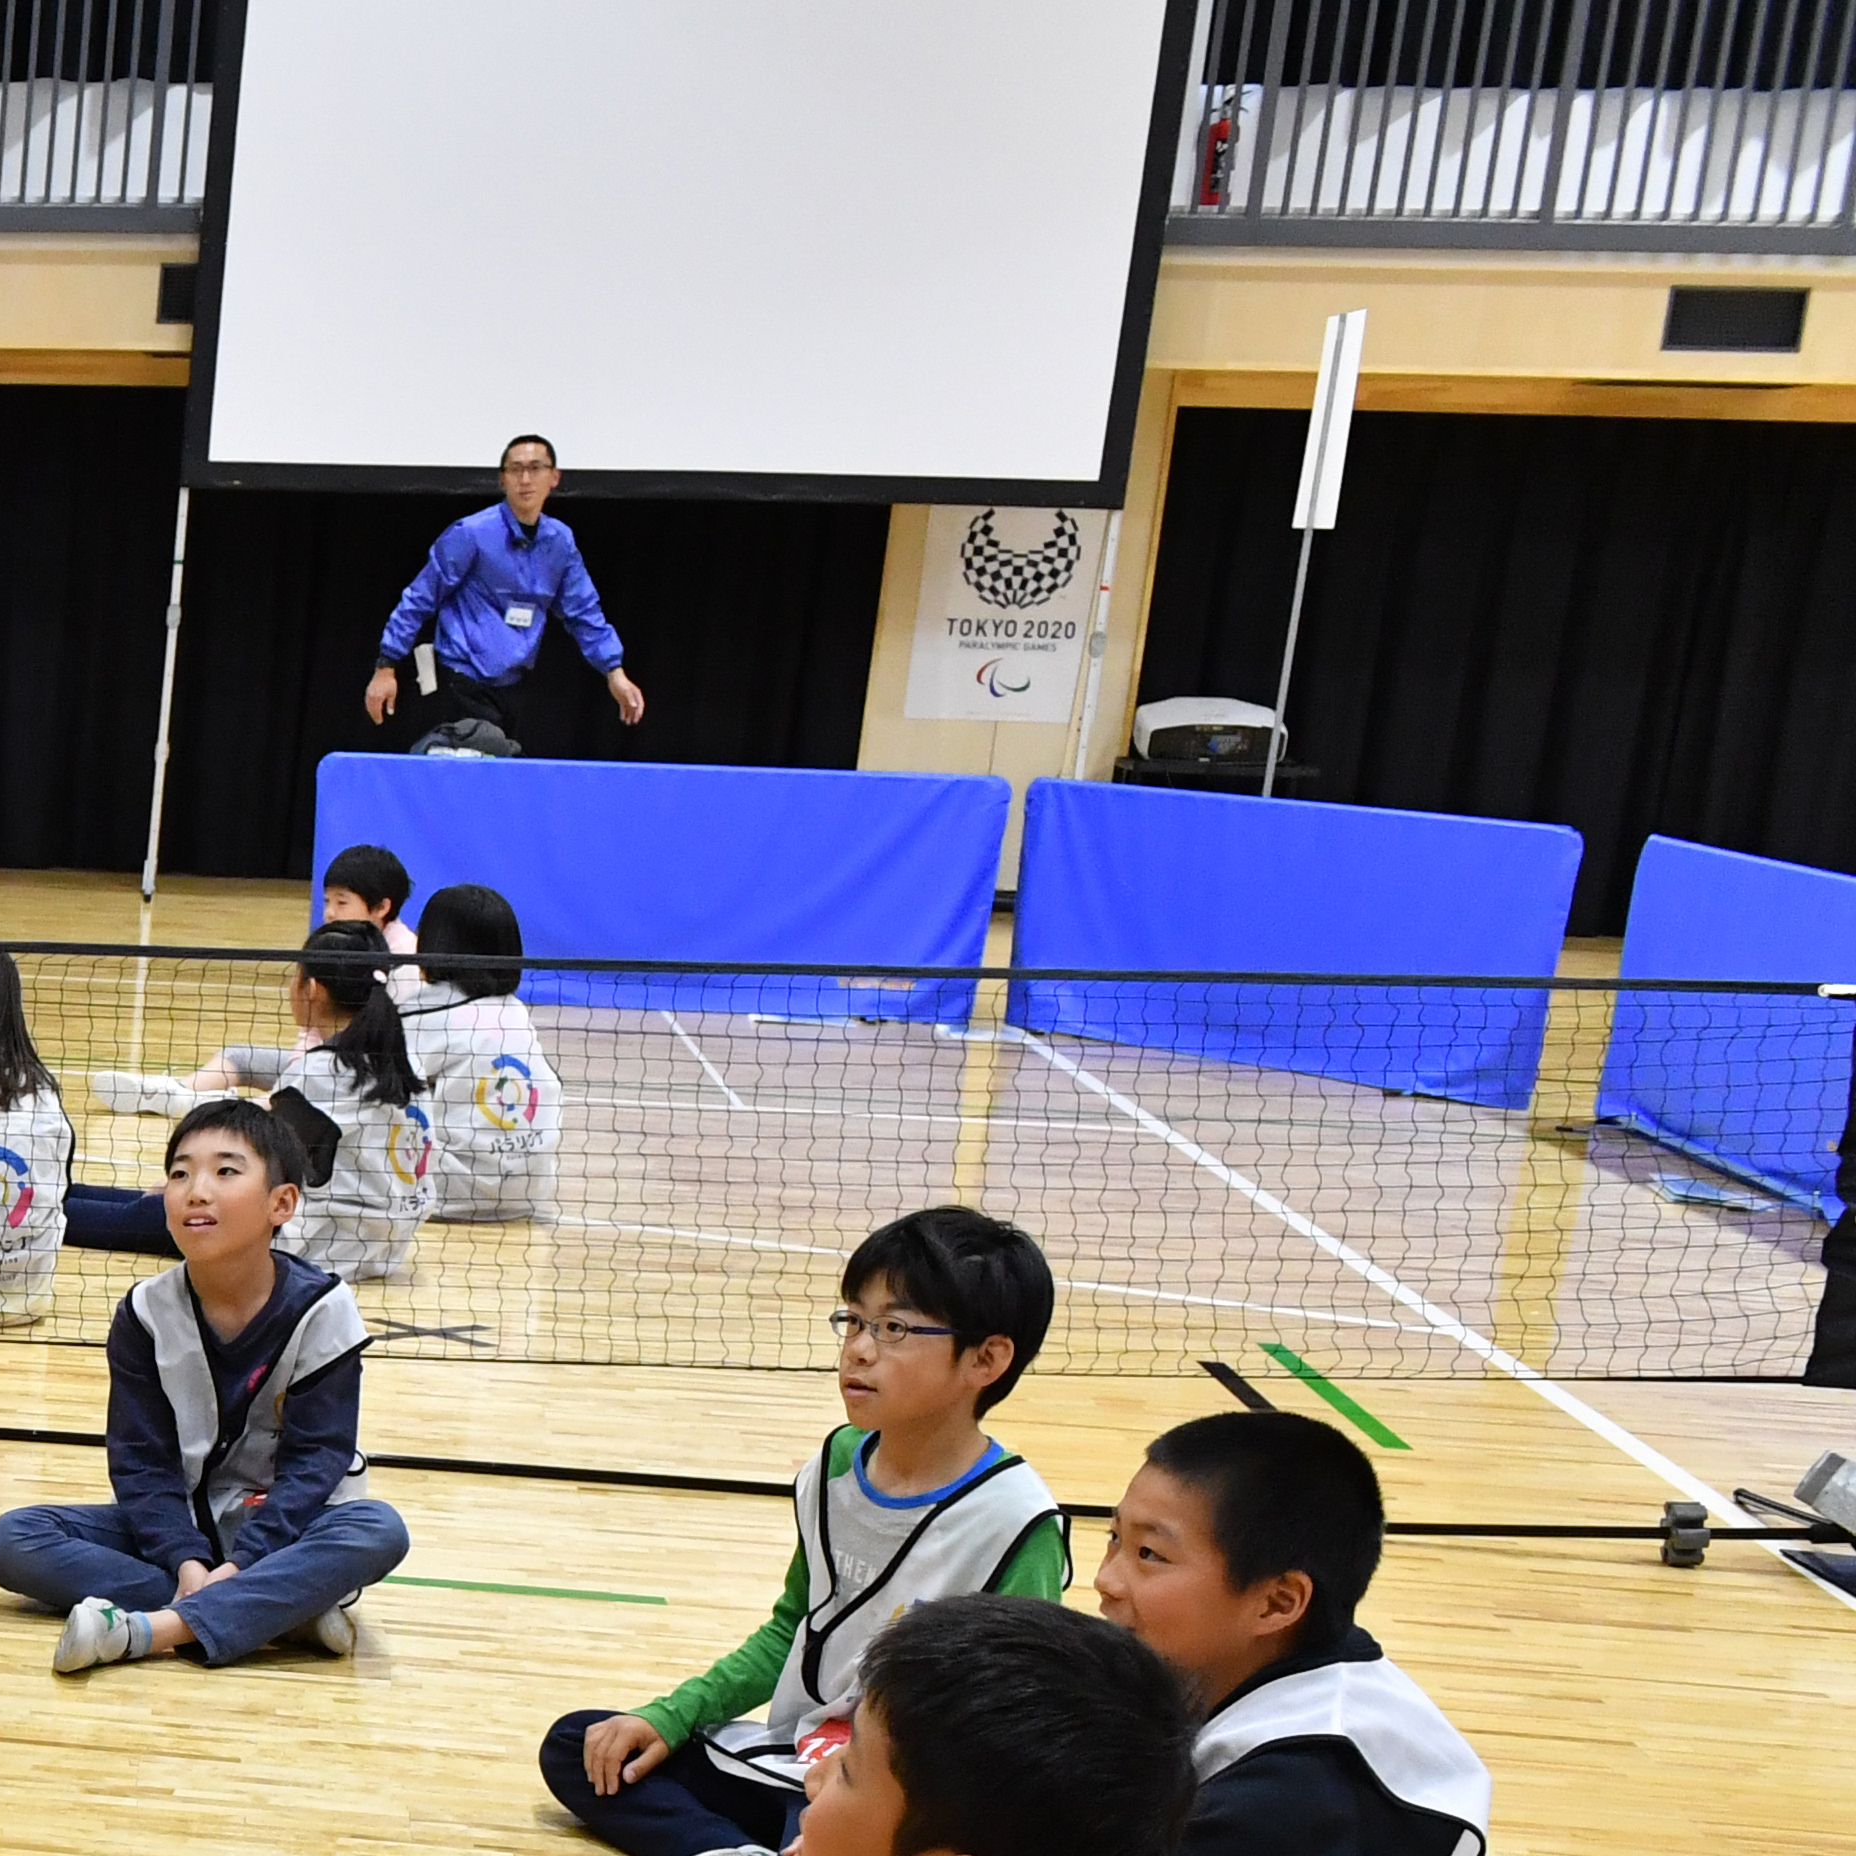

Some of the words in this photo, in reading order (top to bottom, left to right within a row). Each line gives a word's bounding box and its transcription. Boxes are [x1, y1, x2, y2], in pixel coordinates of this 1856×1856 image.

[947, 618, 1018, 638] TOKYO
[1023, 619, 1076, 640] 2020
[958, 640, 1021, 651] PARALYMPIC
[1023, 641, 1057, 652] GAMES
